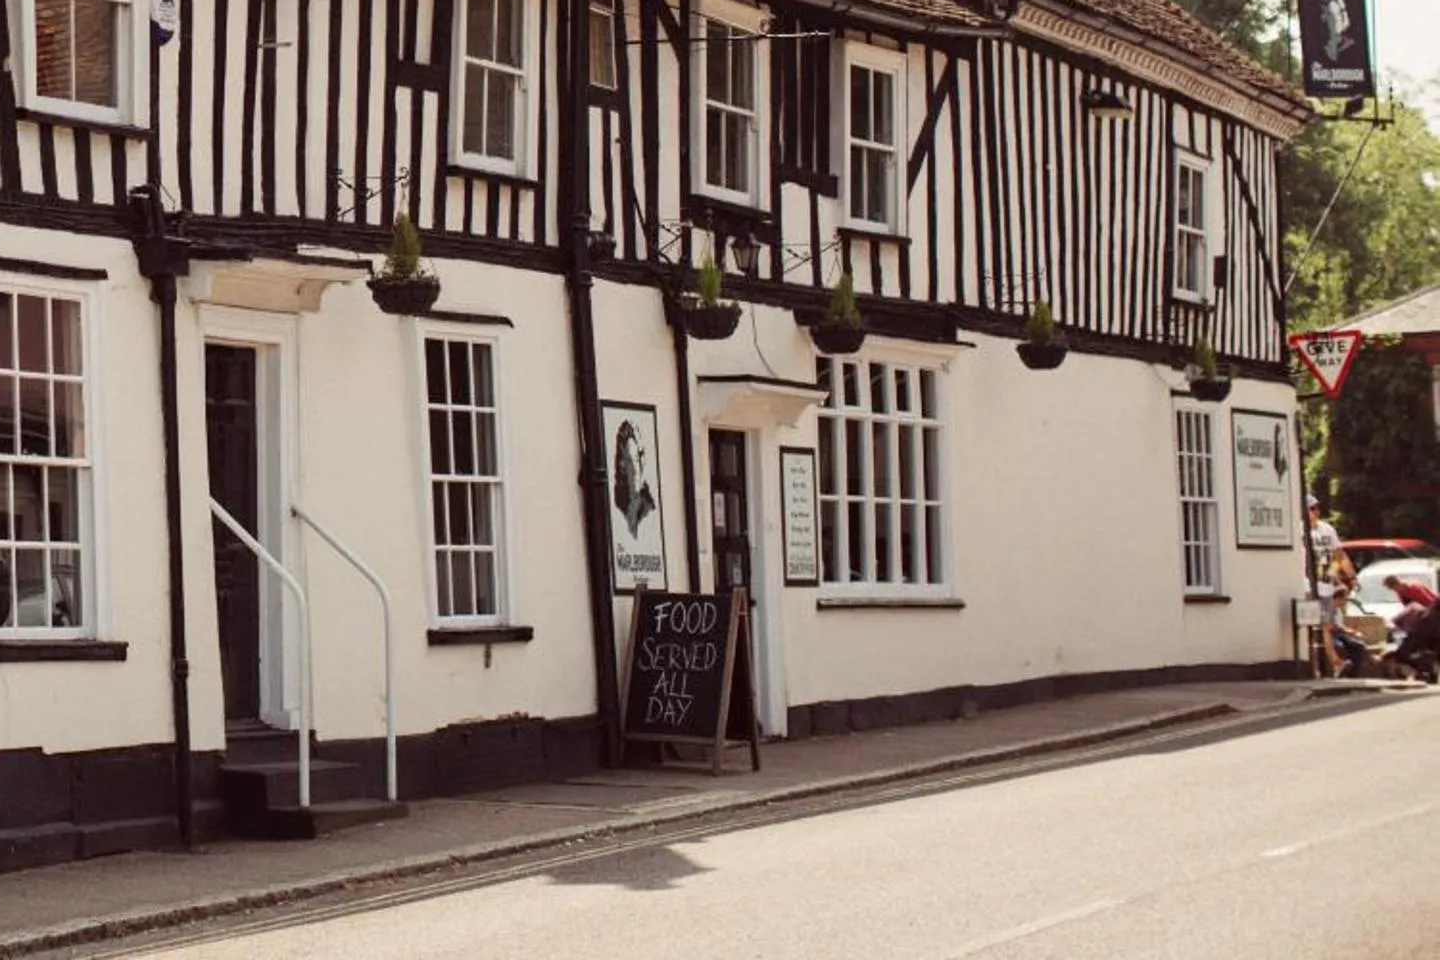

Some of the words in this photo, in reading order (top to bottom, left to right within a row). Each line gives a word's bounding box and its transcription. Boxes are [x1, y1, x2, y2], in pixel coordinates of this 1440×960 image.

[1317, 355, 1342, 366] WAY
[654, 601, 717, 635] FOOD
[638, 637, 717, 671] SERVED
[653, 670, 694, 698] ALL
[645, 696, 692, 725] DAY
